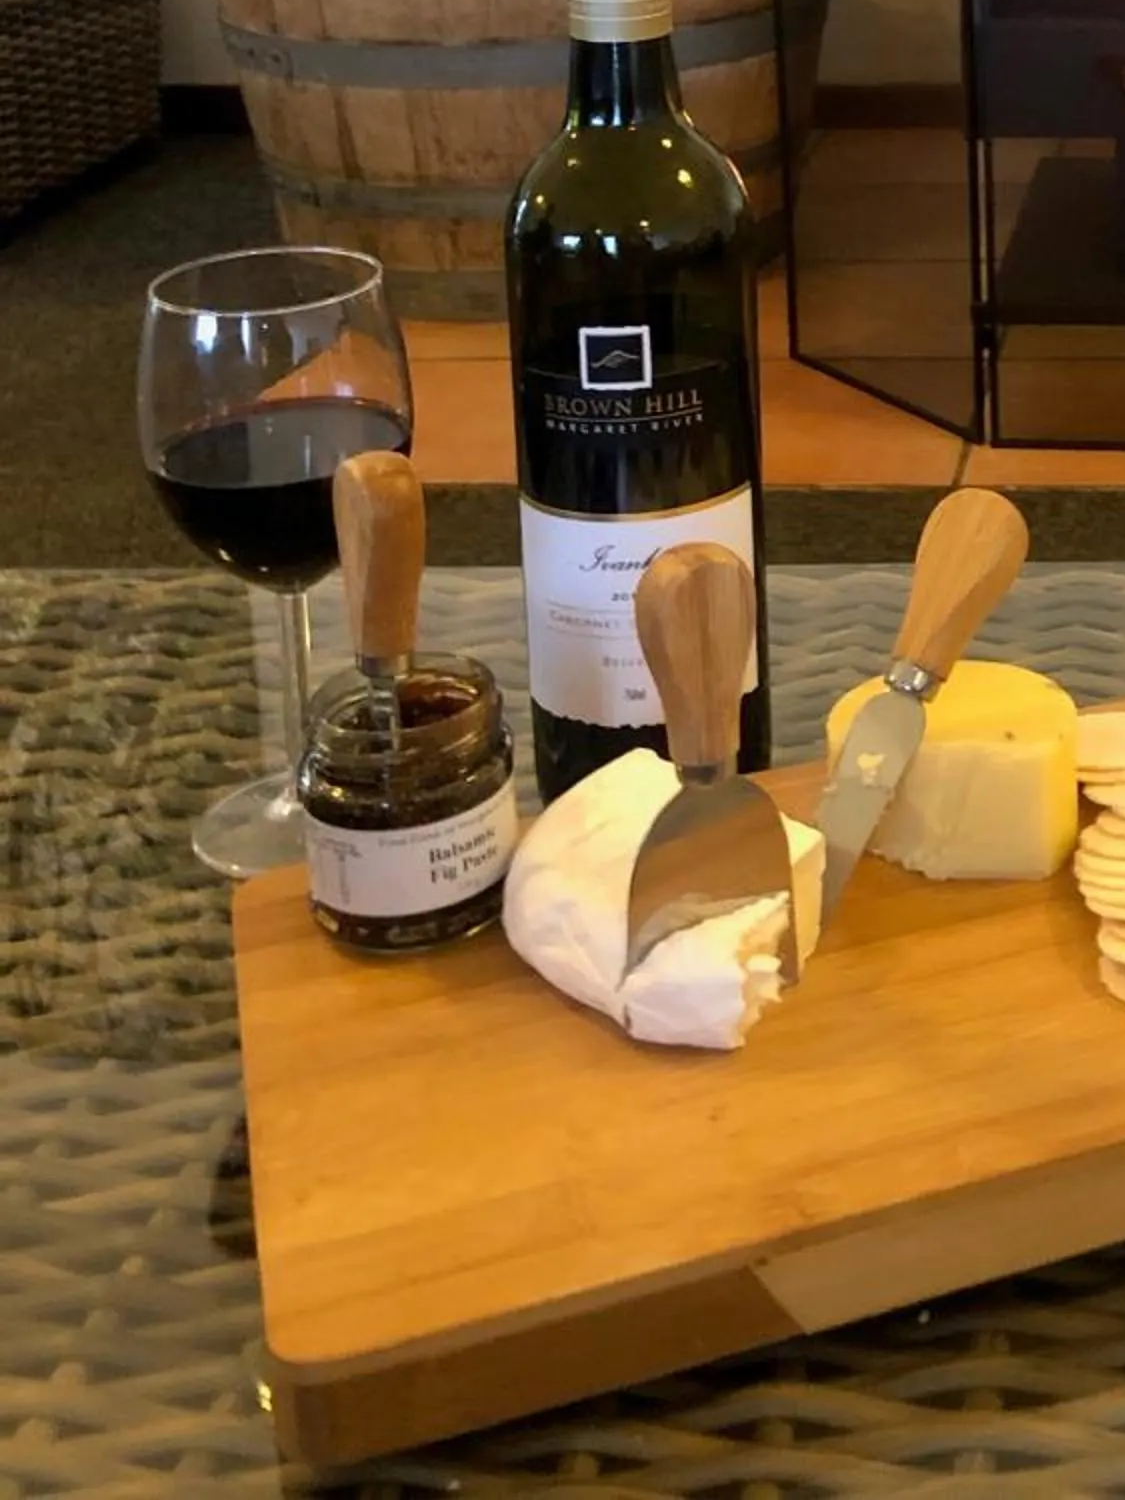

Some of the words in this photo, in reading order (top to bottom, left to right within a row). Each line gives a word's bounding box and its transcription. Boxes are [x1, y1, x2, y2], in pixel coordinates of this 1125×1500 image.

[544, 392, 632, 417] BROWN
[645, 389, 703, 414] HILL
[545, 419, 639, 435] MARGARET
[650, 414, 704, 431] RIVER
[578, 544, 662, 573] Ivan
